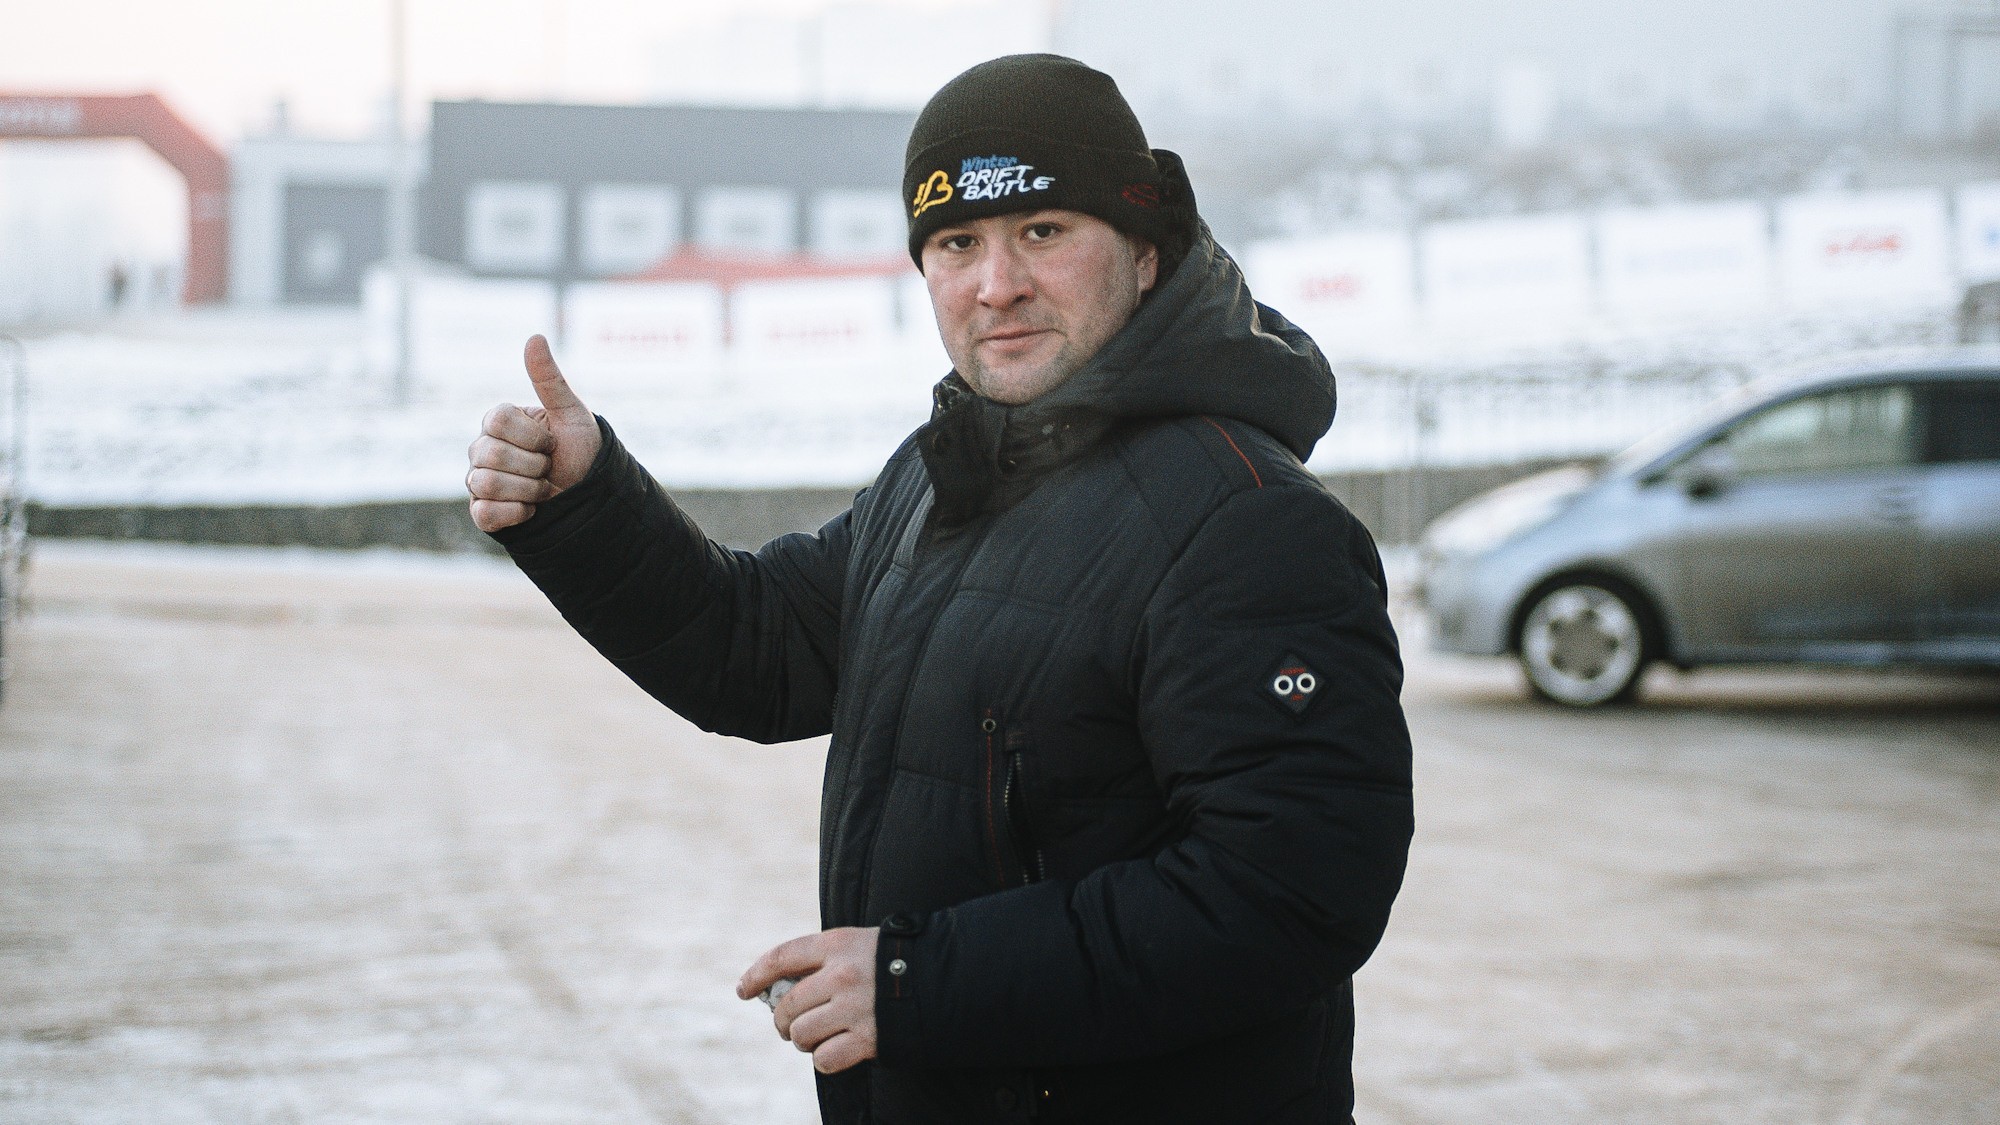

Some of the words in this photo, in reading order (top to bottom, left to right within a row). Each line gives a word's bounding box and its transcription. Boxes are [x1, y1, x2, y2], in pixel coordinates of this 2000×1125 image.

[961, 154, 1018, 173] Winter
[956, 165, 1034, 187] DRIFT
[962, 176, 1056, 200] BATTLE
